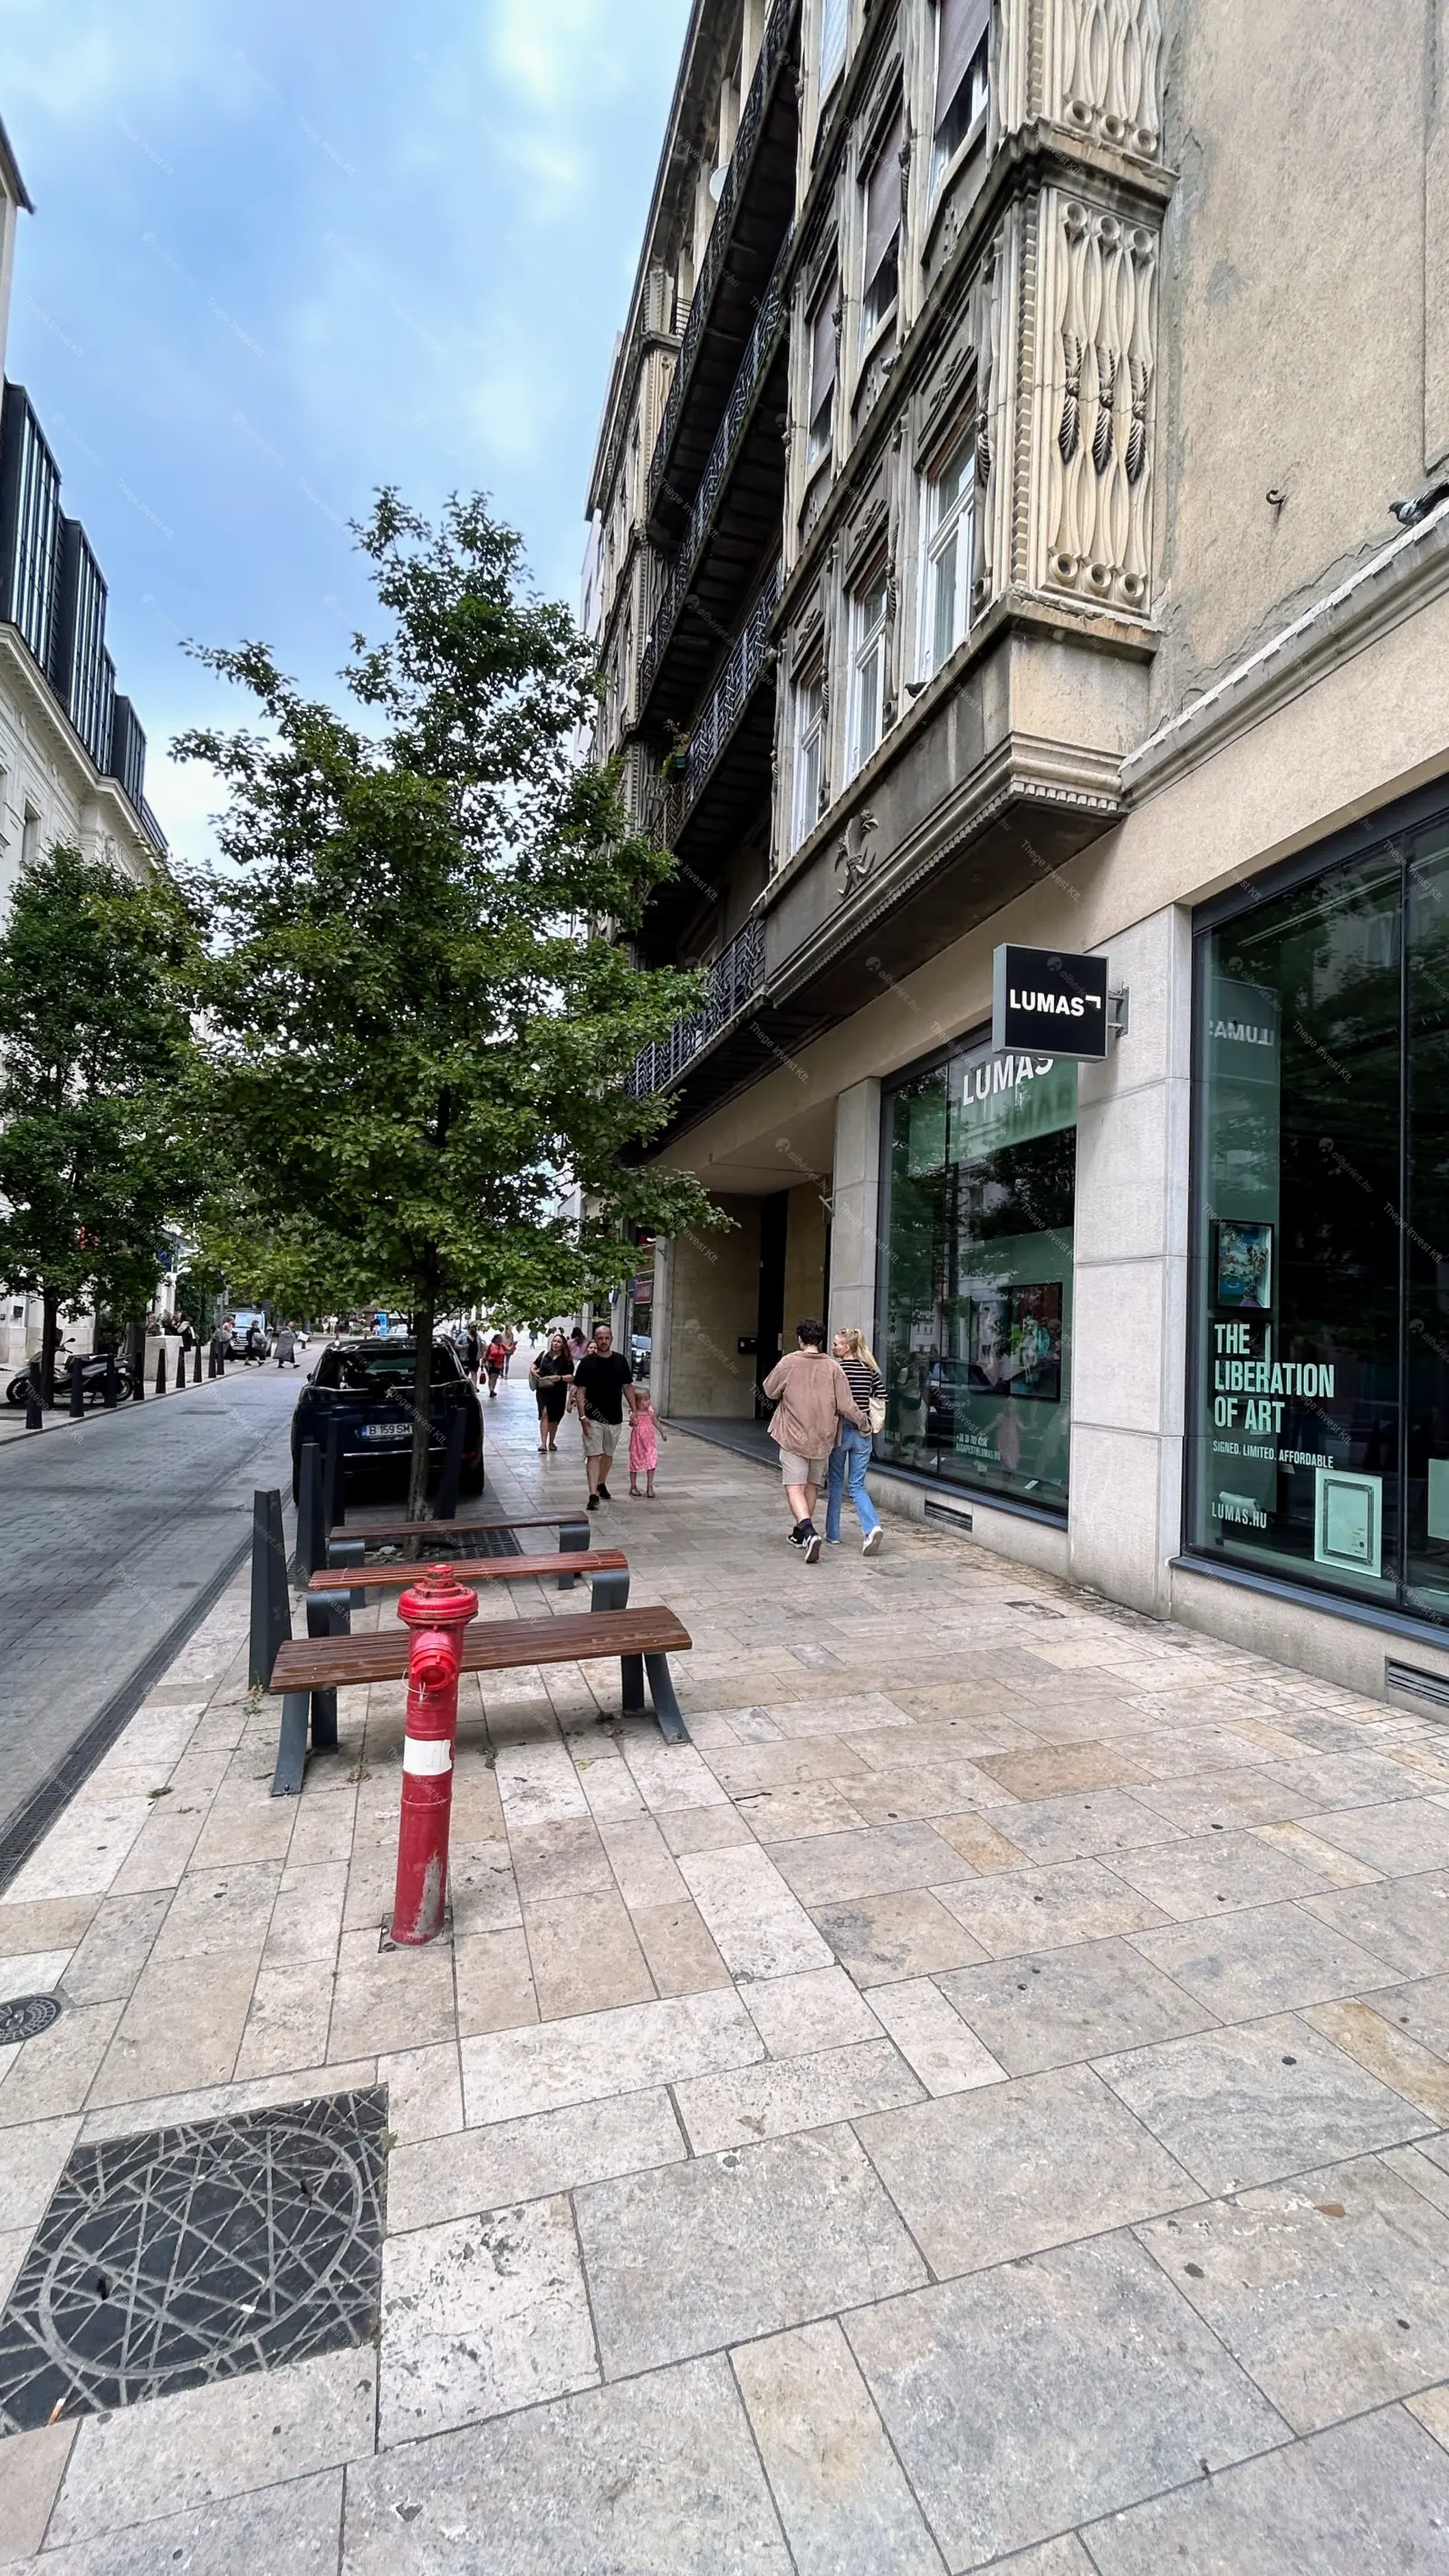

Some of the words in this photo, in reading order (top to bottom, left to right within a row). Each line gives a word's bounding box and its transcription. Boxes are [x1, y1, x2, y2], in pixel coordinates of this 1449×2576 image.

[1010, 989, 1085, 1017] LUMAS
[1214, 1323, 1251, 1354] THE
[1214, 1360, 1335, 1399] LIBERATION
[1214, 1396, 1238, 1427] OF
[1244, 1399, 1285, 1433] ART
[369, 1426, 377, 1435] B
[380, 1425, 395, 1434] 159
[396, 1424, 413, 1434] SM
[1213, 1440, 1242, 1456] SIGNED.
[1243, 1444, 1276, 1461] LIMITED.
[1279, 1449, 1334, 1469] AFFORDABLE
[1212, 1502, 1267, 1529] LUMAS.HU
